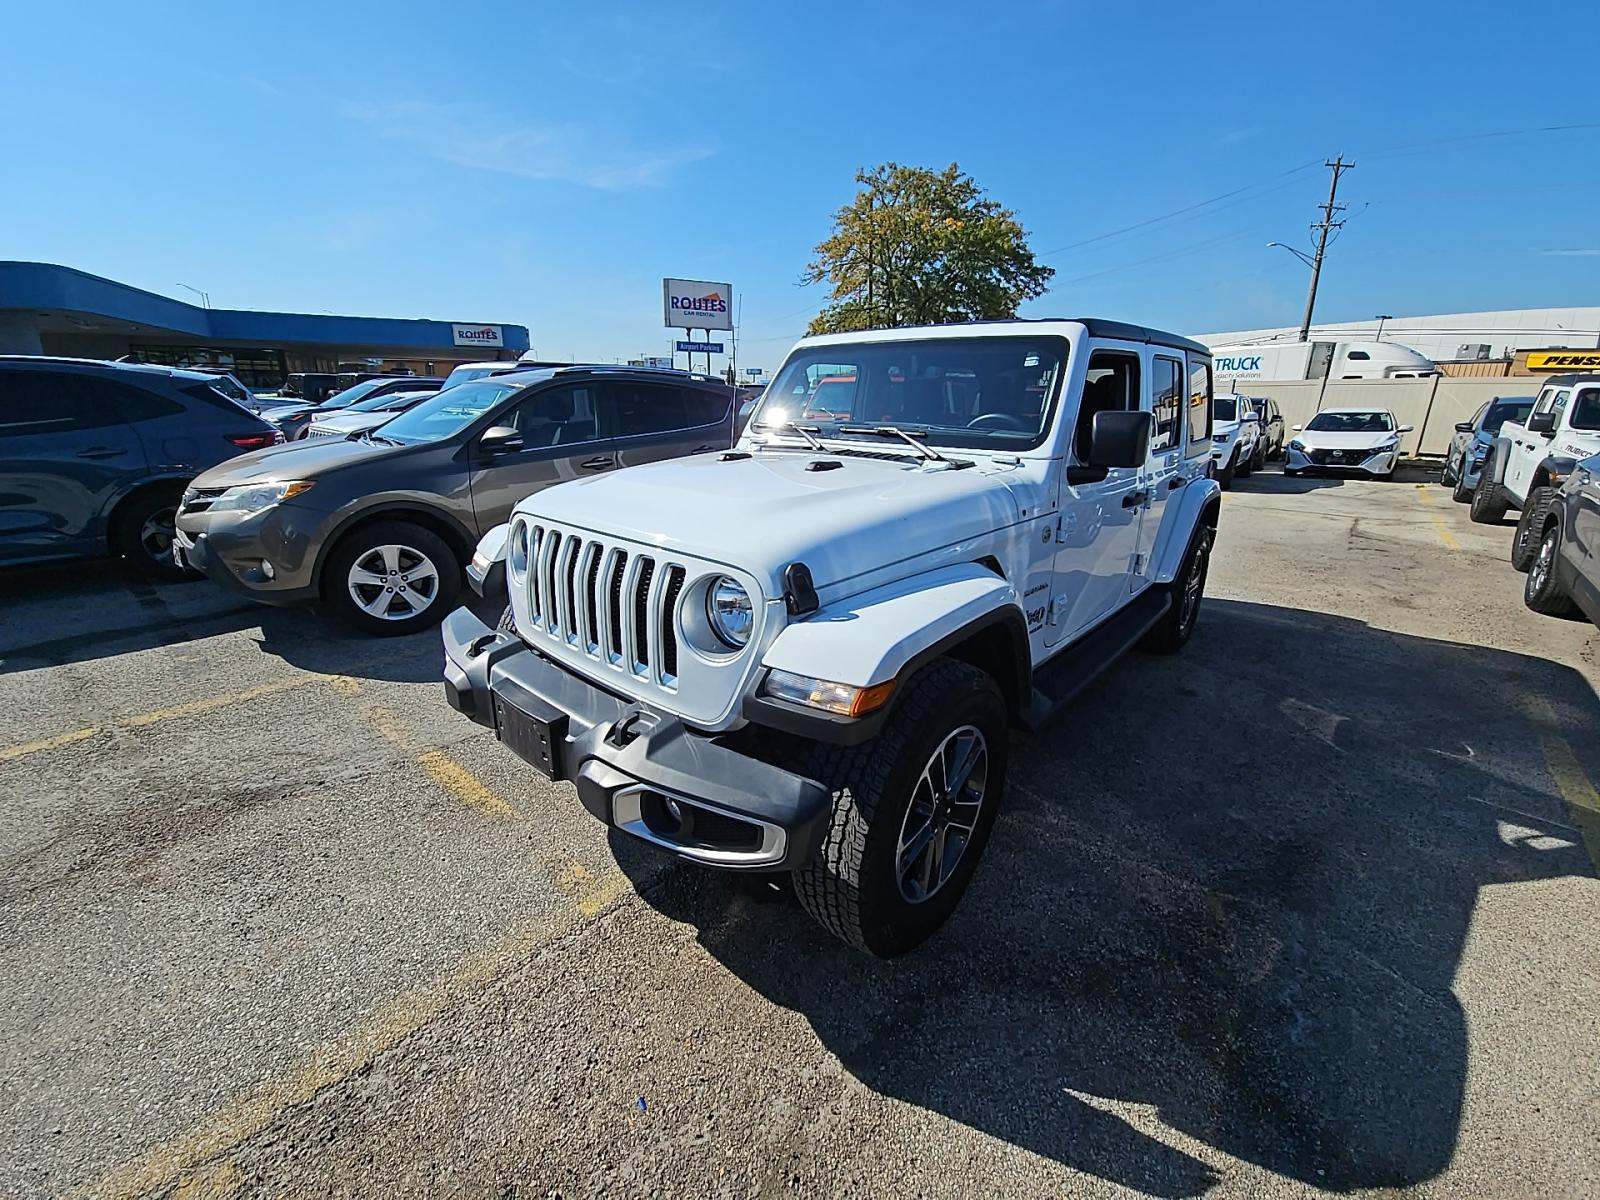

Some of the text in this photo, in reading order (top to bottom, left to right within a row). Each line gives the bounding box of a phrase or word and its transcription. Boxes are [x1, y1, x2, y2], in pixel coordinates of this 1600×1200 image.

[671, 296, 726, 312] ROUTES
[458, 330, 498, 340] ROUTES
[680, 343, 720, 352] Airport Parking
[1215, 356, 1261, 371] TRUCK
[1542, 356, 1600, 365] PENS
